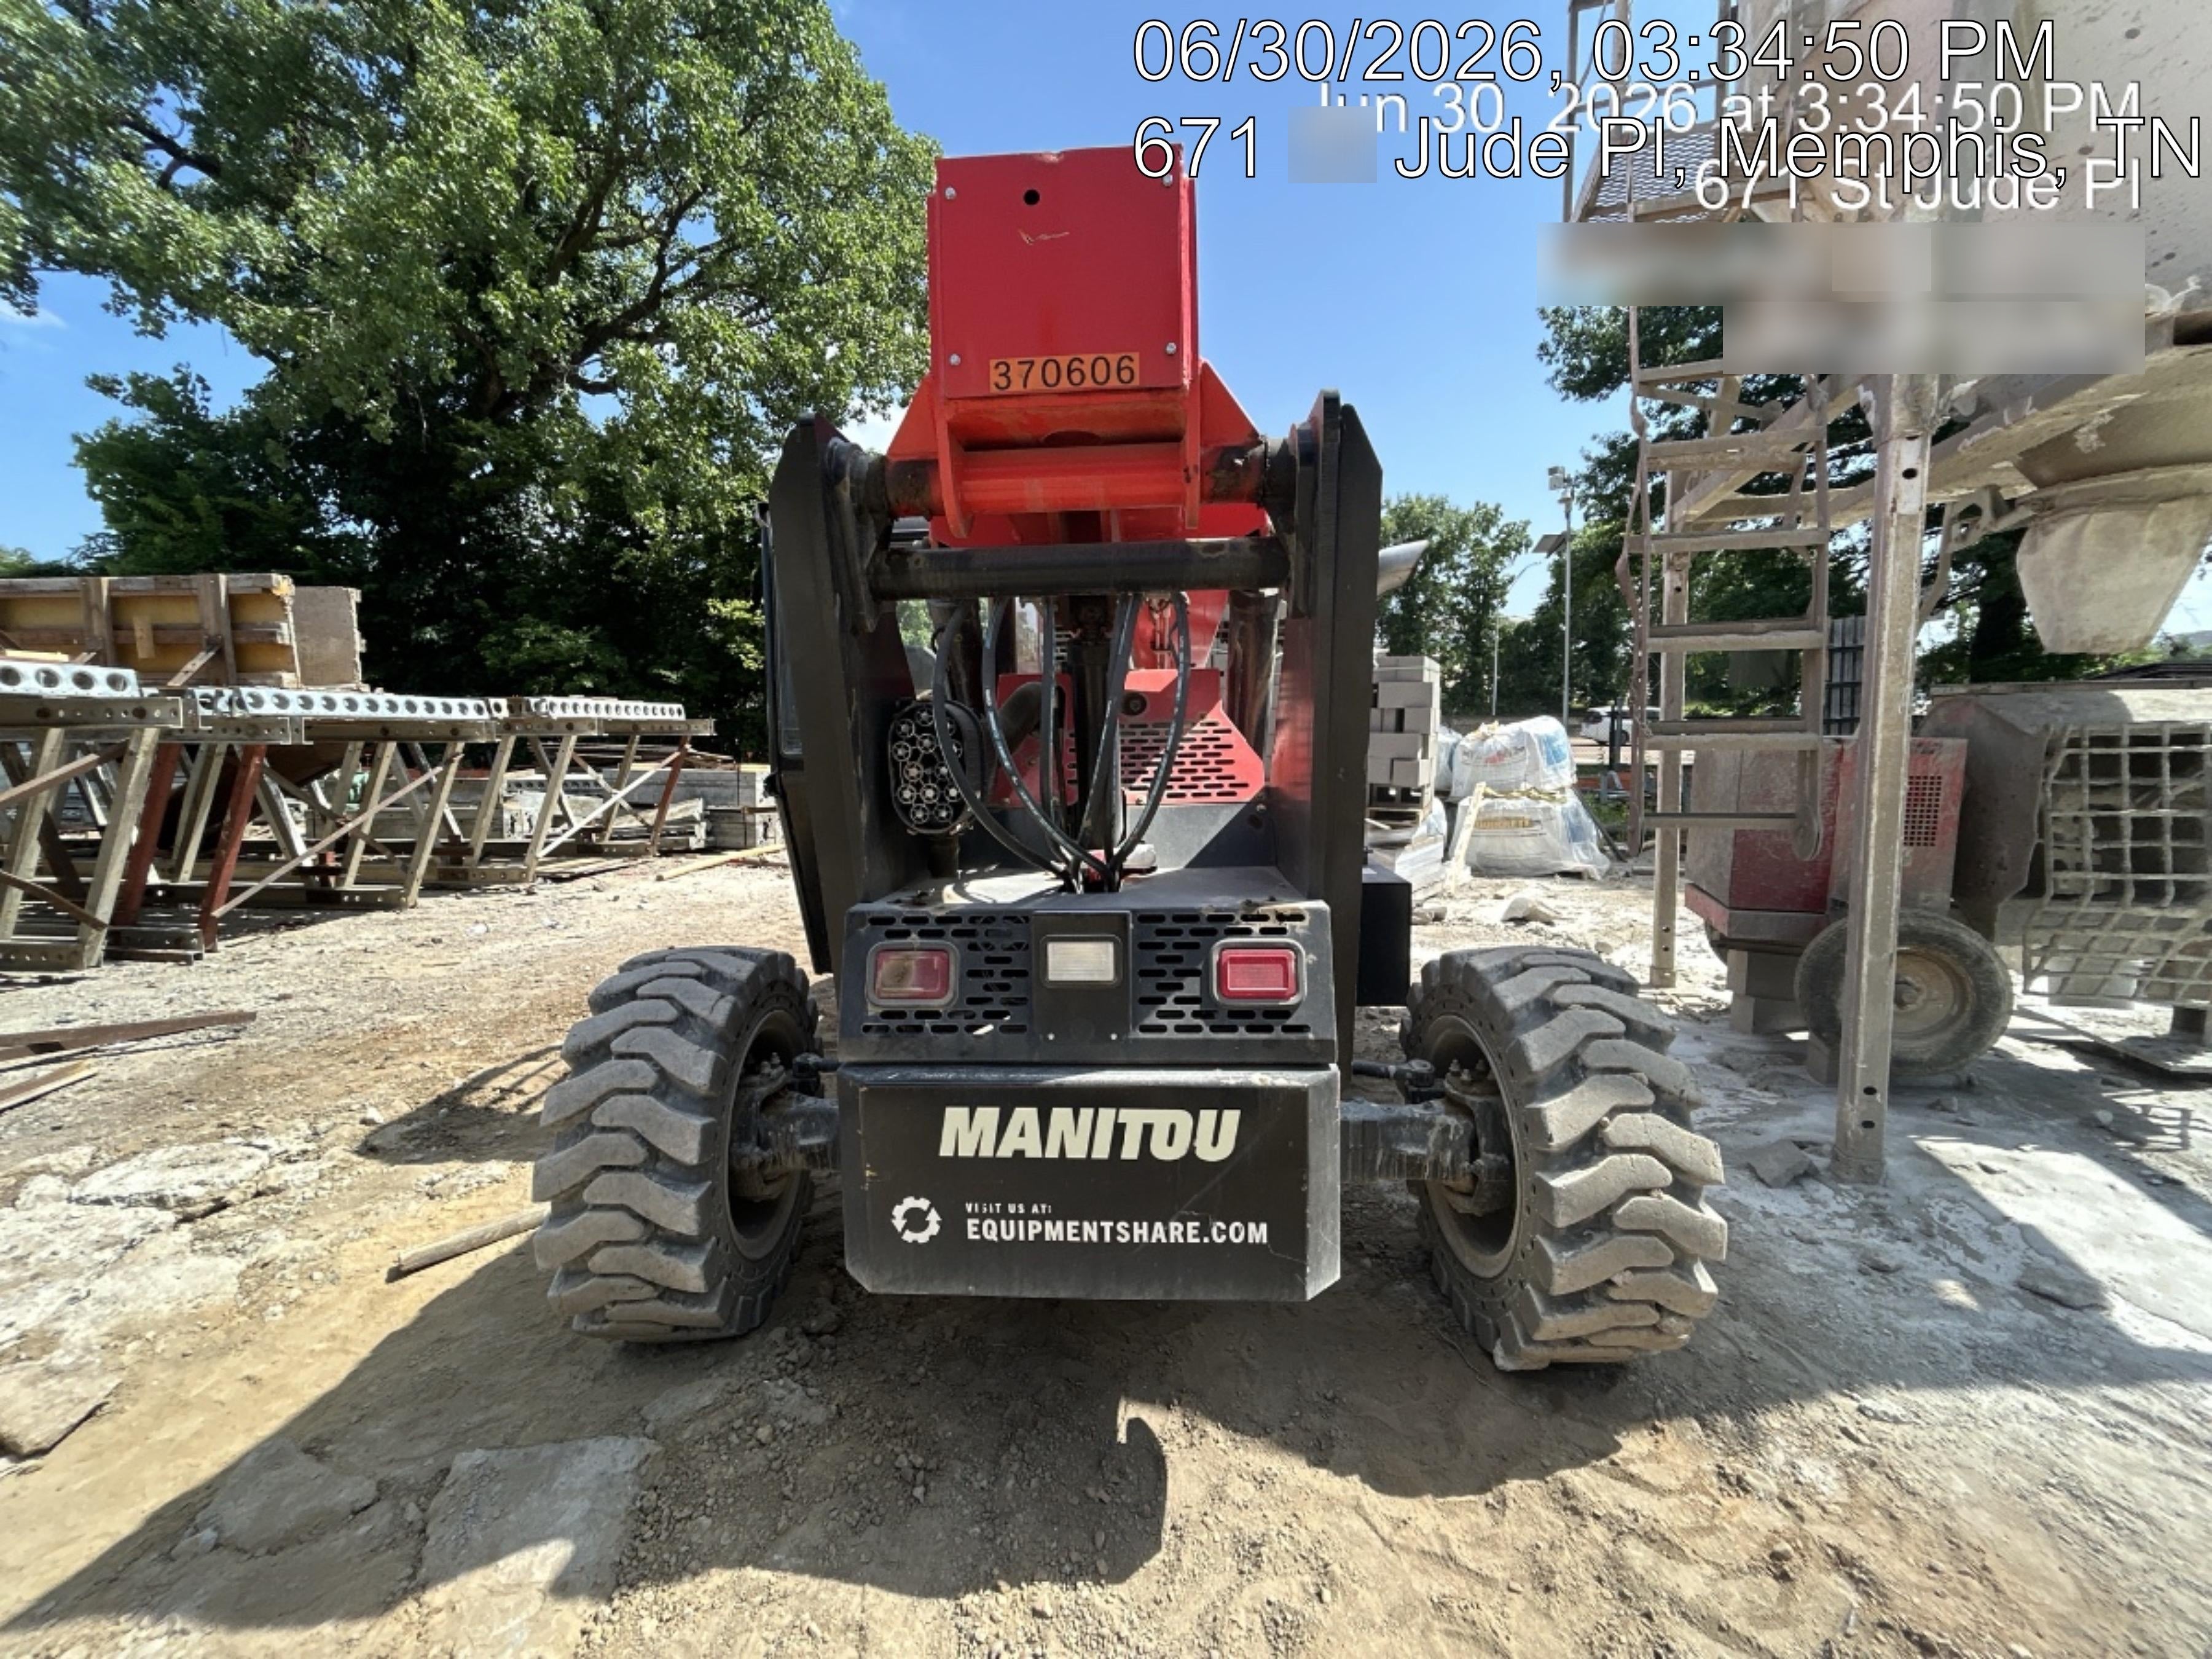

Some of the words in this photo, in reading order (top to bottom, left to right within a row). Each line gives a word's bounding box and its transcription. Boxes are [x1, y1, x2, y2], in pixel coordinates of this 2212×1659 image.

[993, 355, 1136, 391] 370606
[939, 1107, 1241, 1162] MANITOU
[965, 1202, 1002, 1214] VISIT
[1008, 1202, 1026, 1214] US
[1032, 1202, 1052, 1214] AT:
[967, 1218, 1268, 1245] EQUIPMENTSHARE.COM
